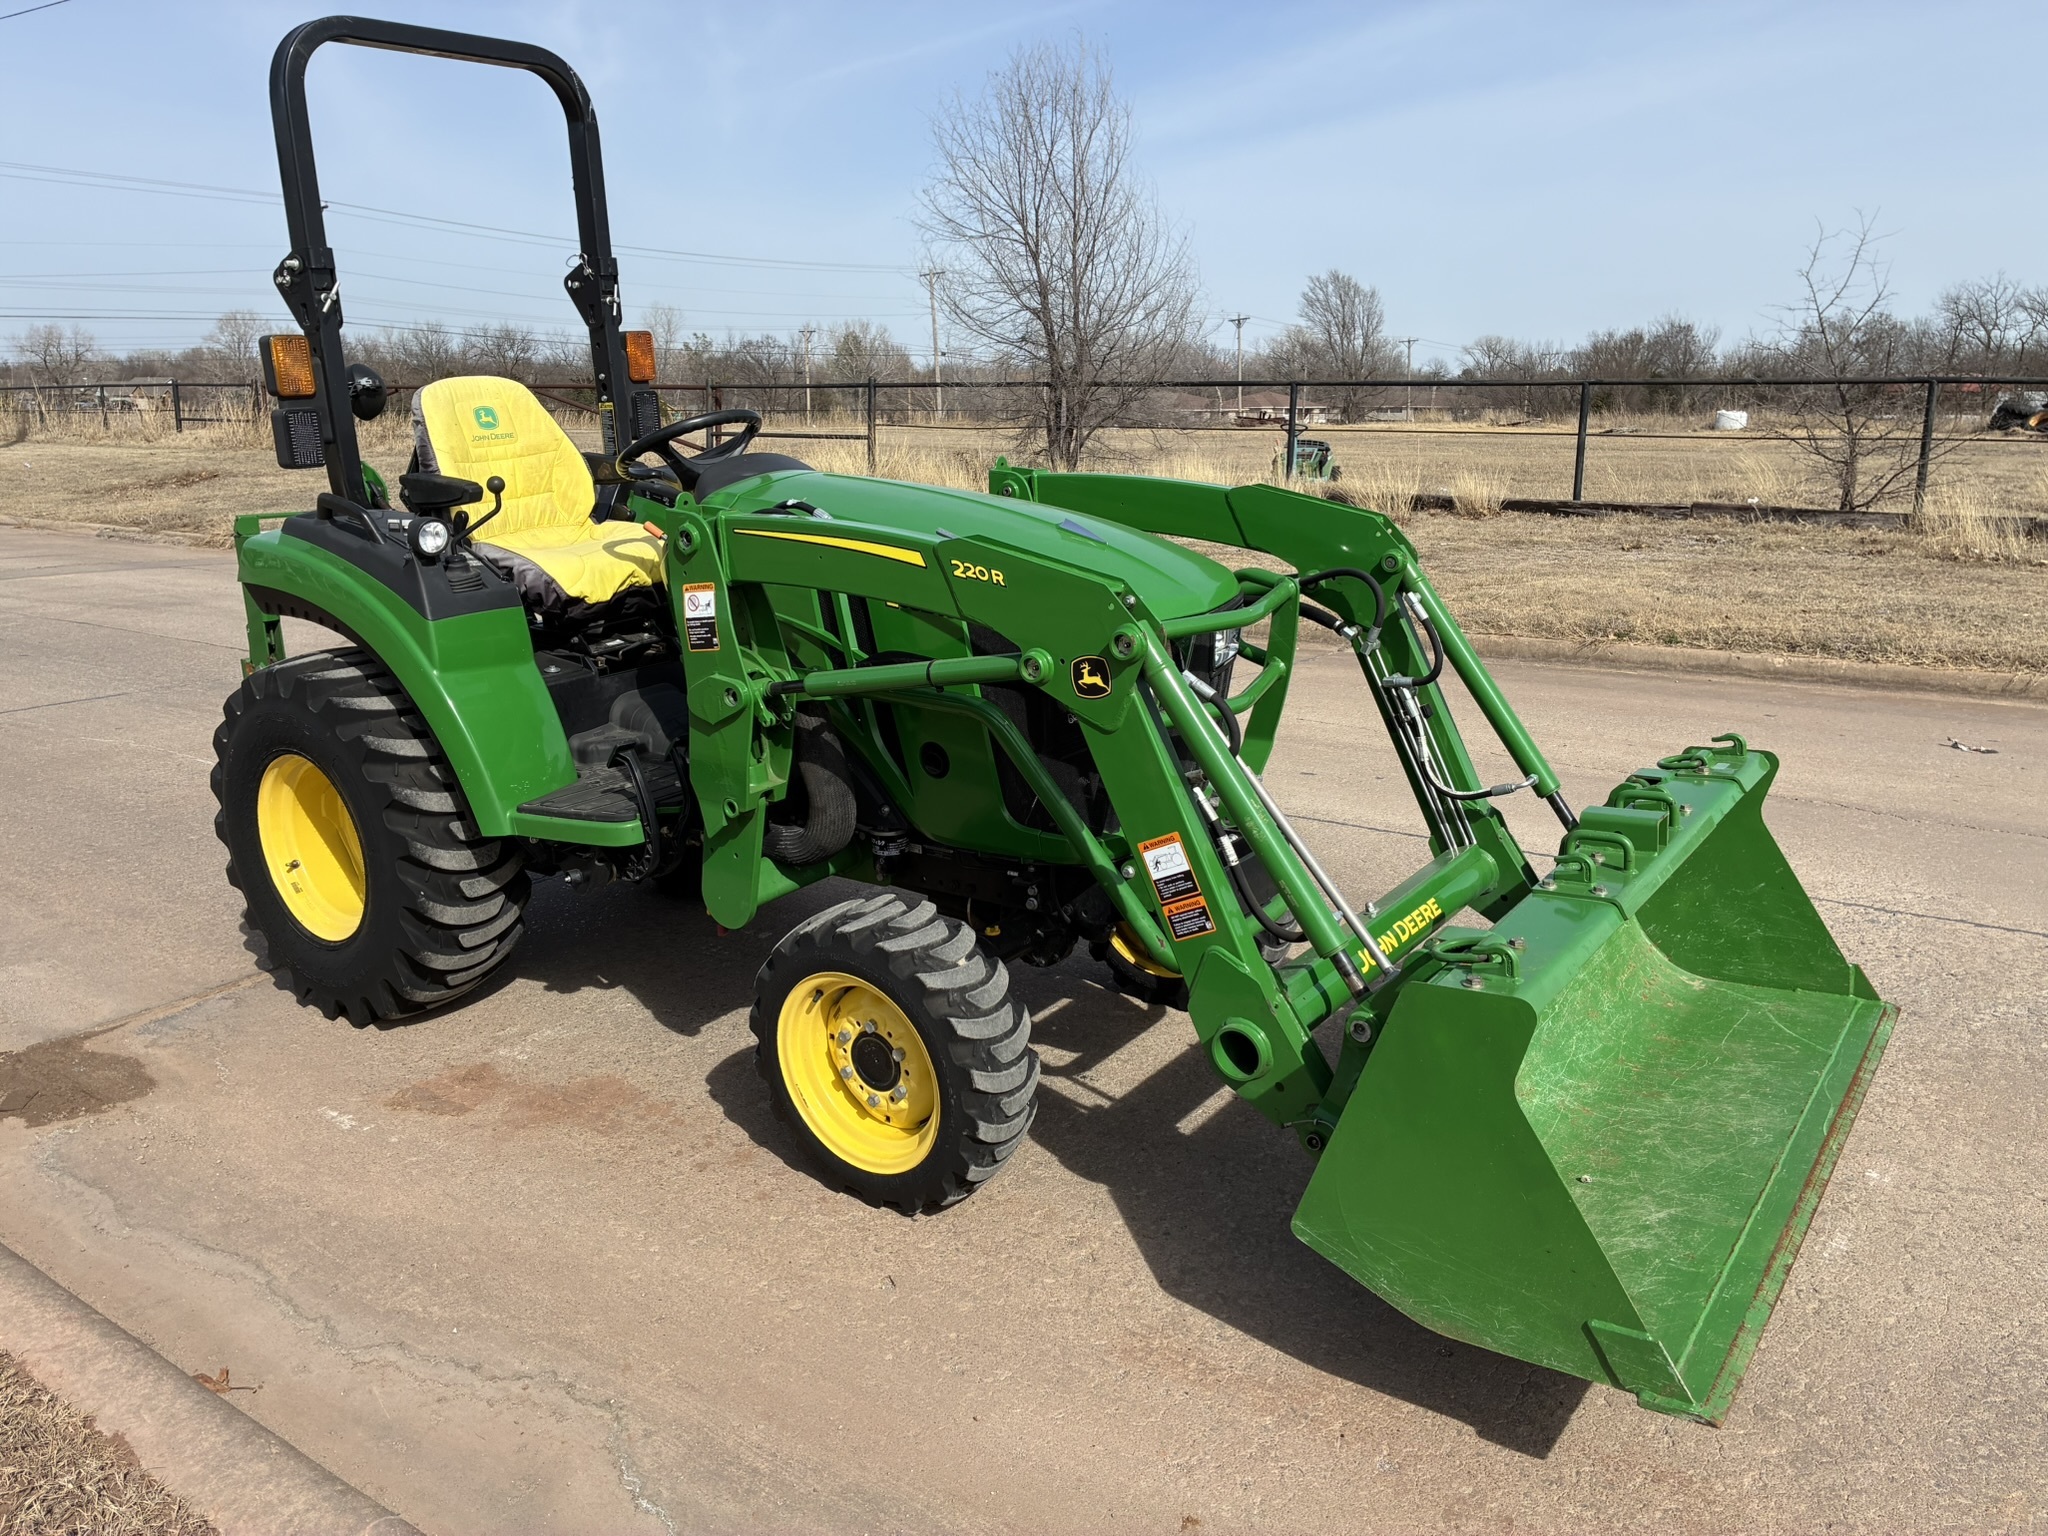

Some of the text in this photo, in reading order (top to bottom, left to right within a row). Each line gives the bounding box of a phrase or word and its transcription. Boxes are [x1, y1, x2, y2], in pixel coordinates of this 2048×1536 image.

[471, 432, 515, 443] JOHN DEERE
[689, 583, 714, 592] WARNING
[1149, 835, 1176, 849] WARNING
[1173, 900, 1201, 912] WARNING
[1392, 897, 1442, 943] DEERE
